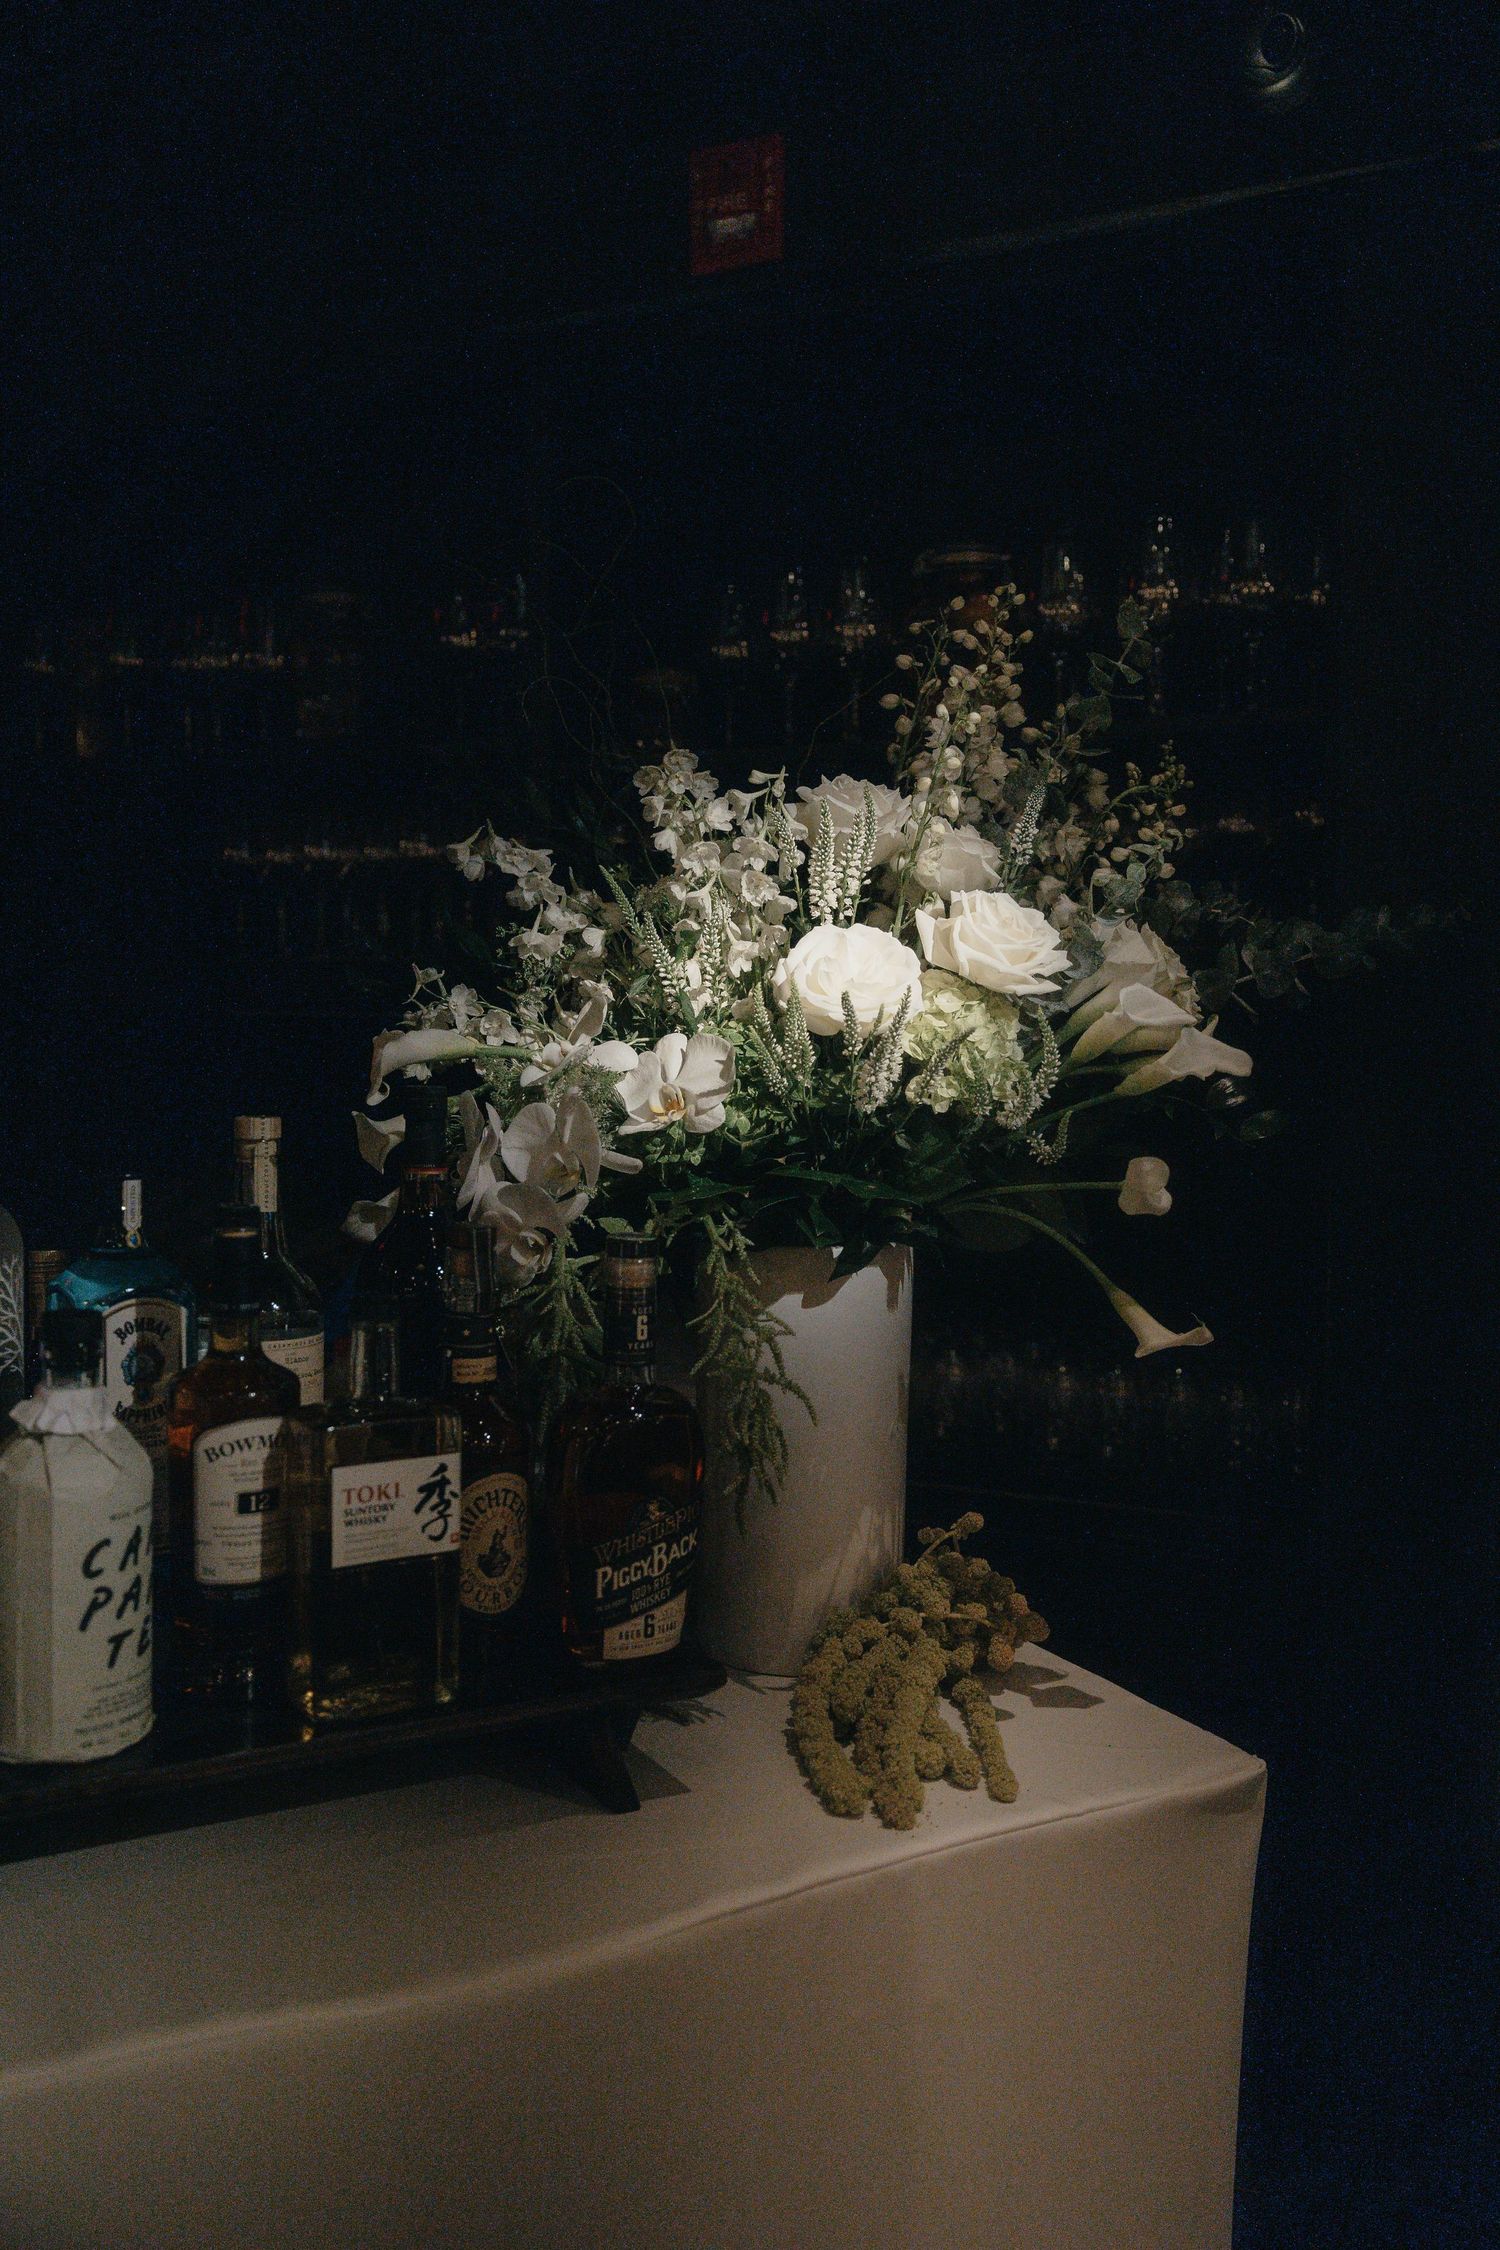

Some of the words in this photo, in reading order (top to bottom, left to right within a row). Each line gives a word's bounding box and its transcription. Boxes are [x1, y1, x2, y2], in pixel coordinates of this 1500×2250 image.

[113, 1317, 172, 1345] BOMBAY
[636, 1314, 649, 1342] 6
[249, 1493, 272, 1513] 12
[342, 1482, 401, 1505] TOKI
[343, 1503, 396, 1517] SUNTORY
[343, 1515, 387, 1528] WHISKY
[652, 1571, 672, 1592] RYE
[630, 1586, 673, 1614] WHISKEY
[618, 1629, 642, 1641] AGED
[643, 1614, 655, 1638] 6
[657, 1621, 678, 1635] YEARS
